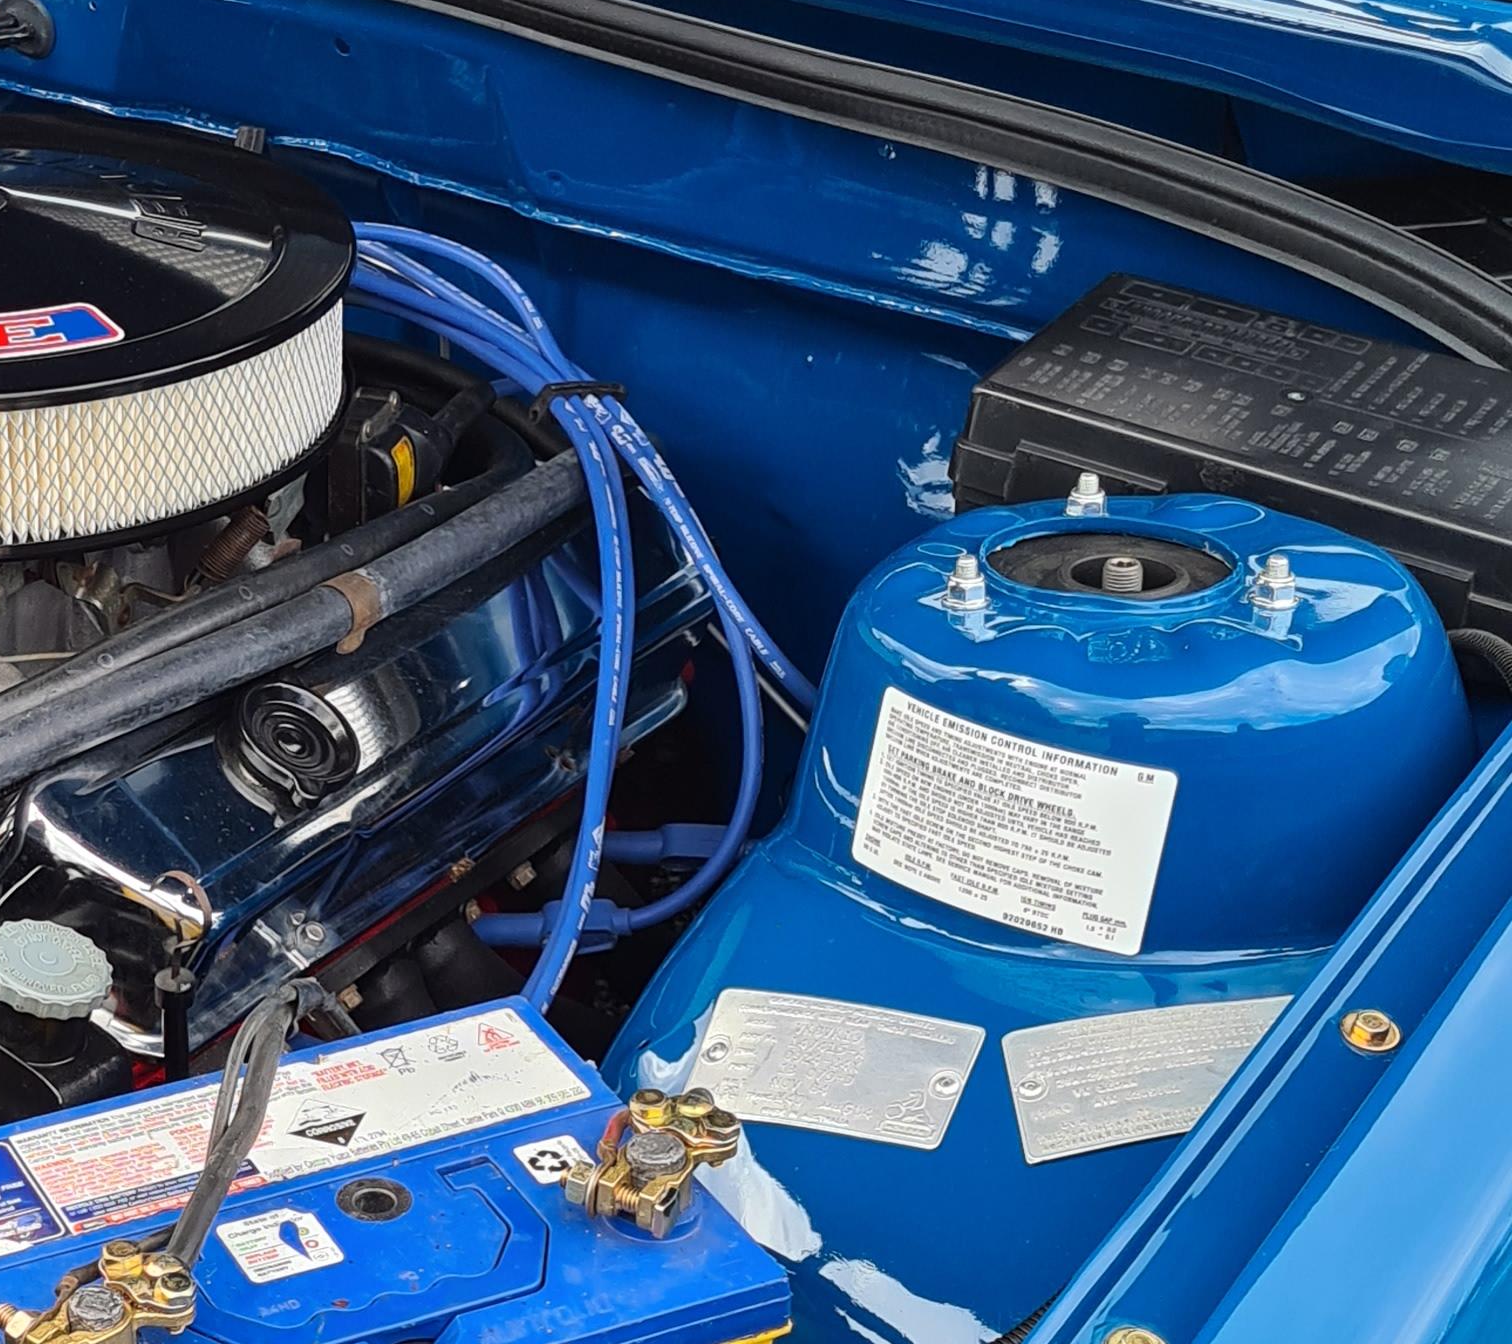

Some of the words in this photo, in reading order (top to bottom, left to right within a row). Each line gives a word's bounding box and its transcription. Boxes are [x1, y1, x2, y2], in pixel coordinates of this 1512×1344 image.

[744, 627, 771, 657] CABLE
[906, 700, 940, 724] VEHICLE
[941, 716, 988, 742] EMISSION
[989, 734, 1037, 757] CONTROL
[1040, 749, 1118, 776] INFORMATION
[887, 743, 899, 756] SET
[899, 749, 930, 771] PARKING
[931, 764, 957, 781] BRAKE
[958, 775, 976, 789] AND
[977, 781, 1005, 798] BLOCK
[1006, 791, 1034, 807] DRIVE
[396, 1065, 417, 1075] Pb
[302, 1117, 357, 1138] CORROSIVE
[0, 1179, 26, 1192] FREE
[227, 1226, 263, 1240] Charge
